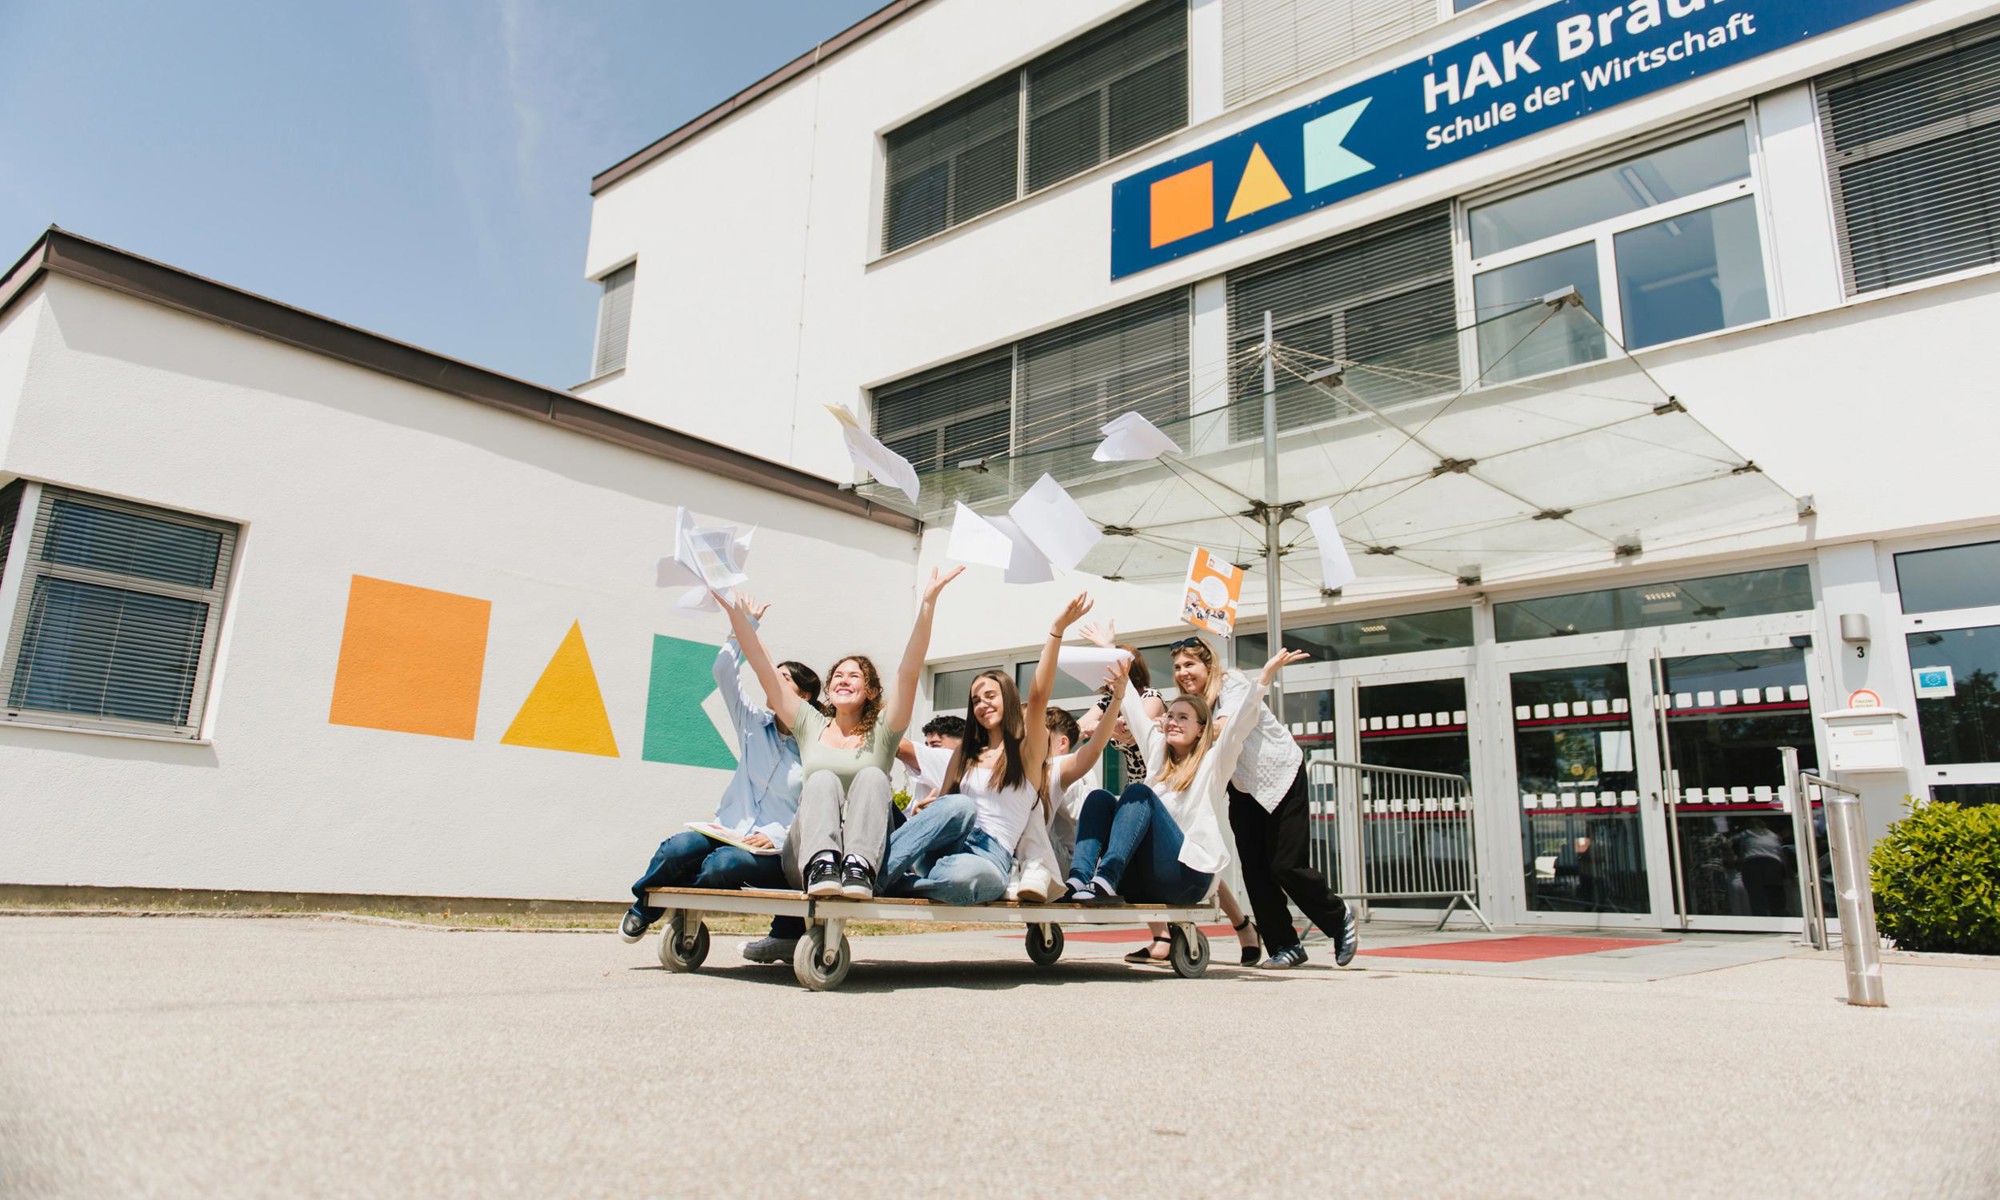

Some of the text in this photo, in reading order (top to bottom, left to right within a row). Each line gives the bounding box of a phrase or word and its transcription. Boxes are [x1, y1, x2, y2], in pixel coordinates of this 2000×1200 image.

[1423, 30, 1542, 115] HAK
[1425, 12, 1757, 151] Schule der Wirtschaft
[1856, 646, 1865, 659] 3
